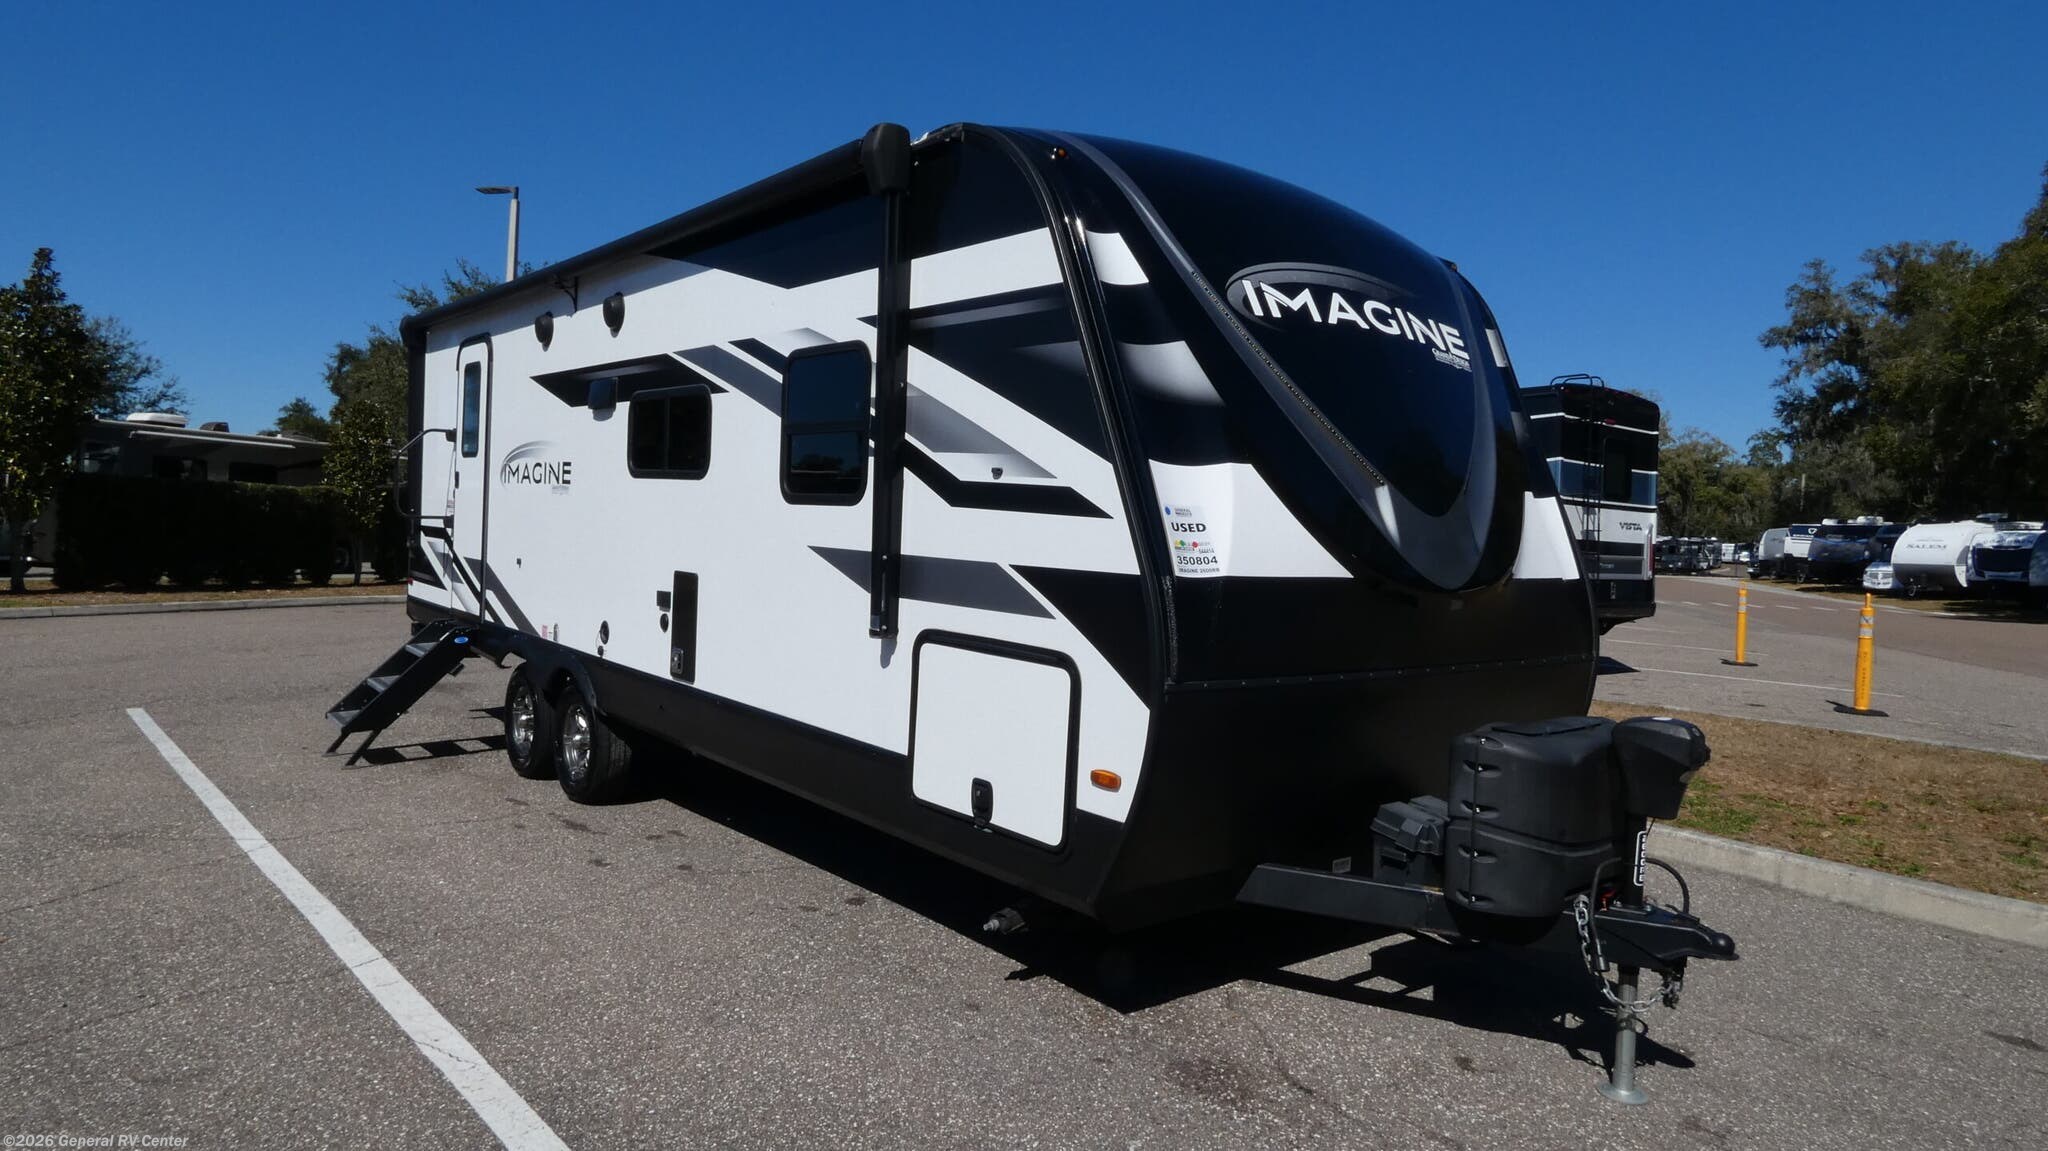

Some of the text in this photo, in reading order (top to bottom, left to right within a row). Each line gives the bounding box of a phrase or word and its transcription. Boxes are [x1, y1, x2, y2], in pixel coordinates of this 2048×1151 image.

[1242, 280, 1470, 360] IMAGINE
[503, 461, 572, 485] IMAGINE
[1171, 522, 1207, 532] USED
[1177, 555, 1218, 566] 350804
